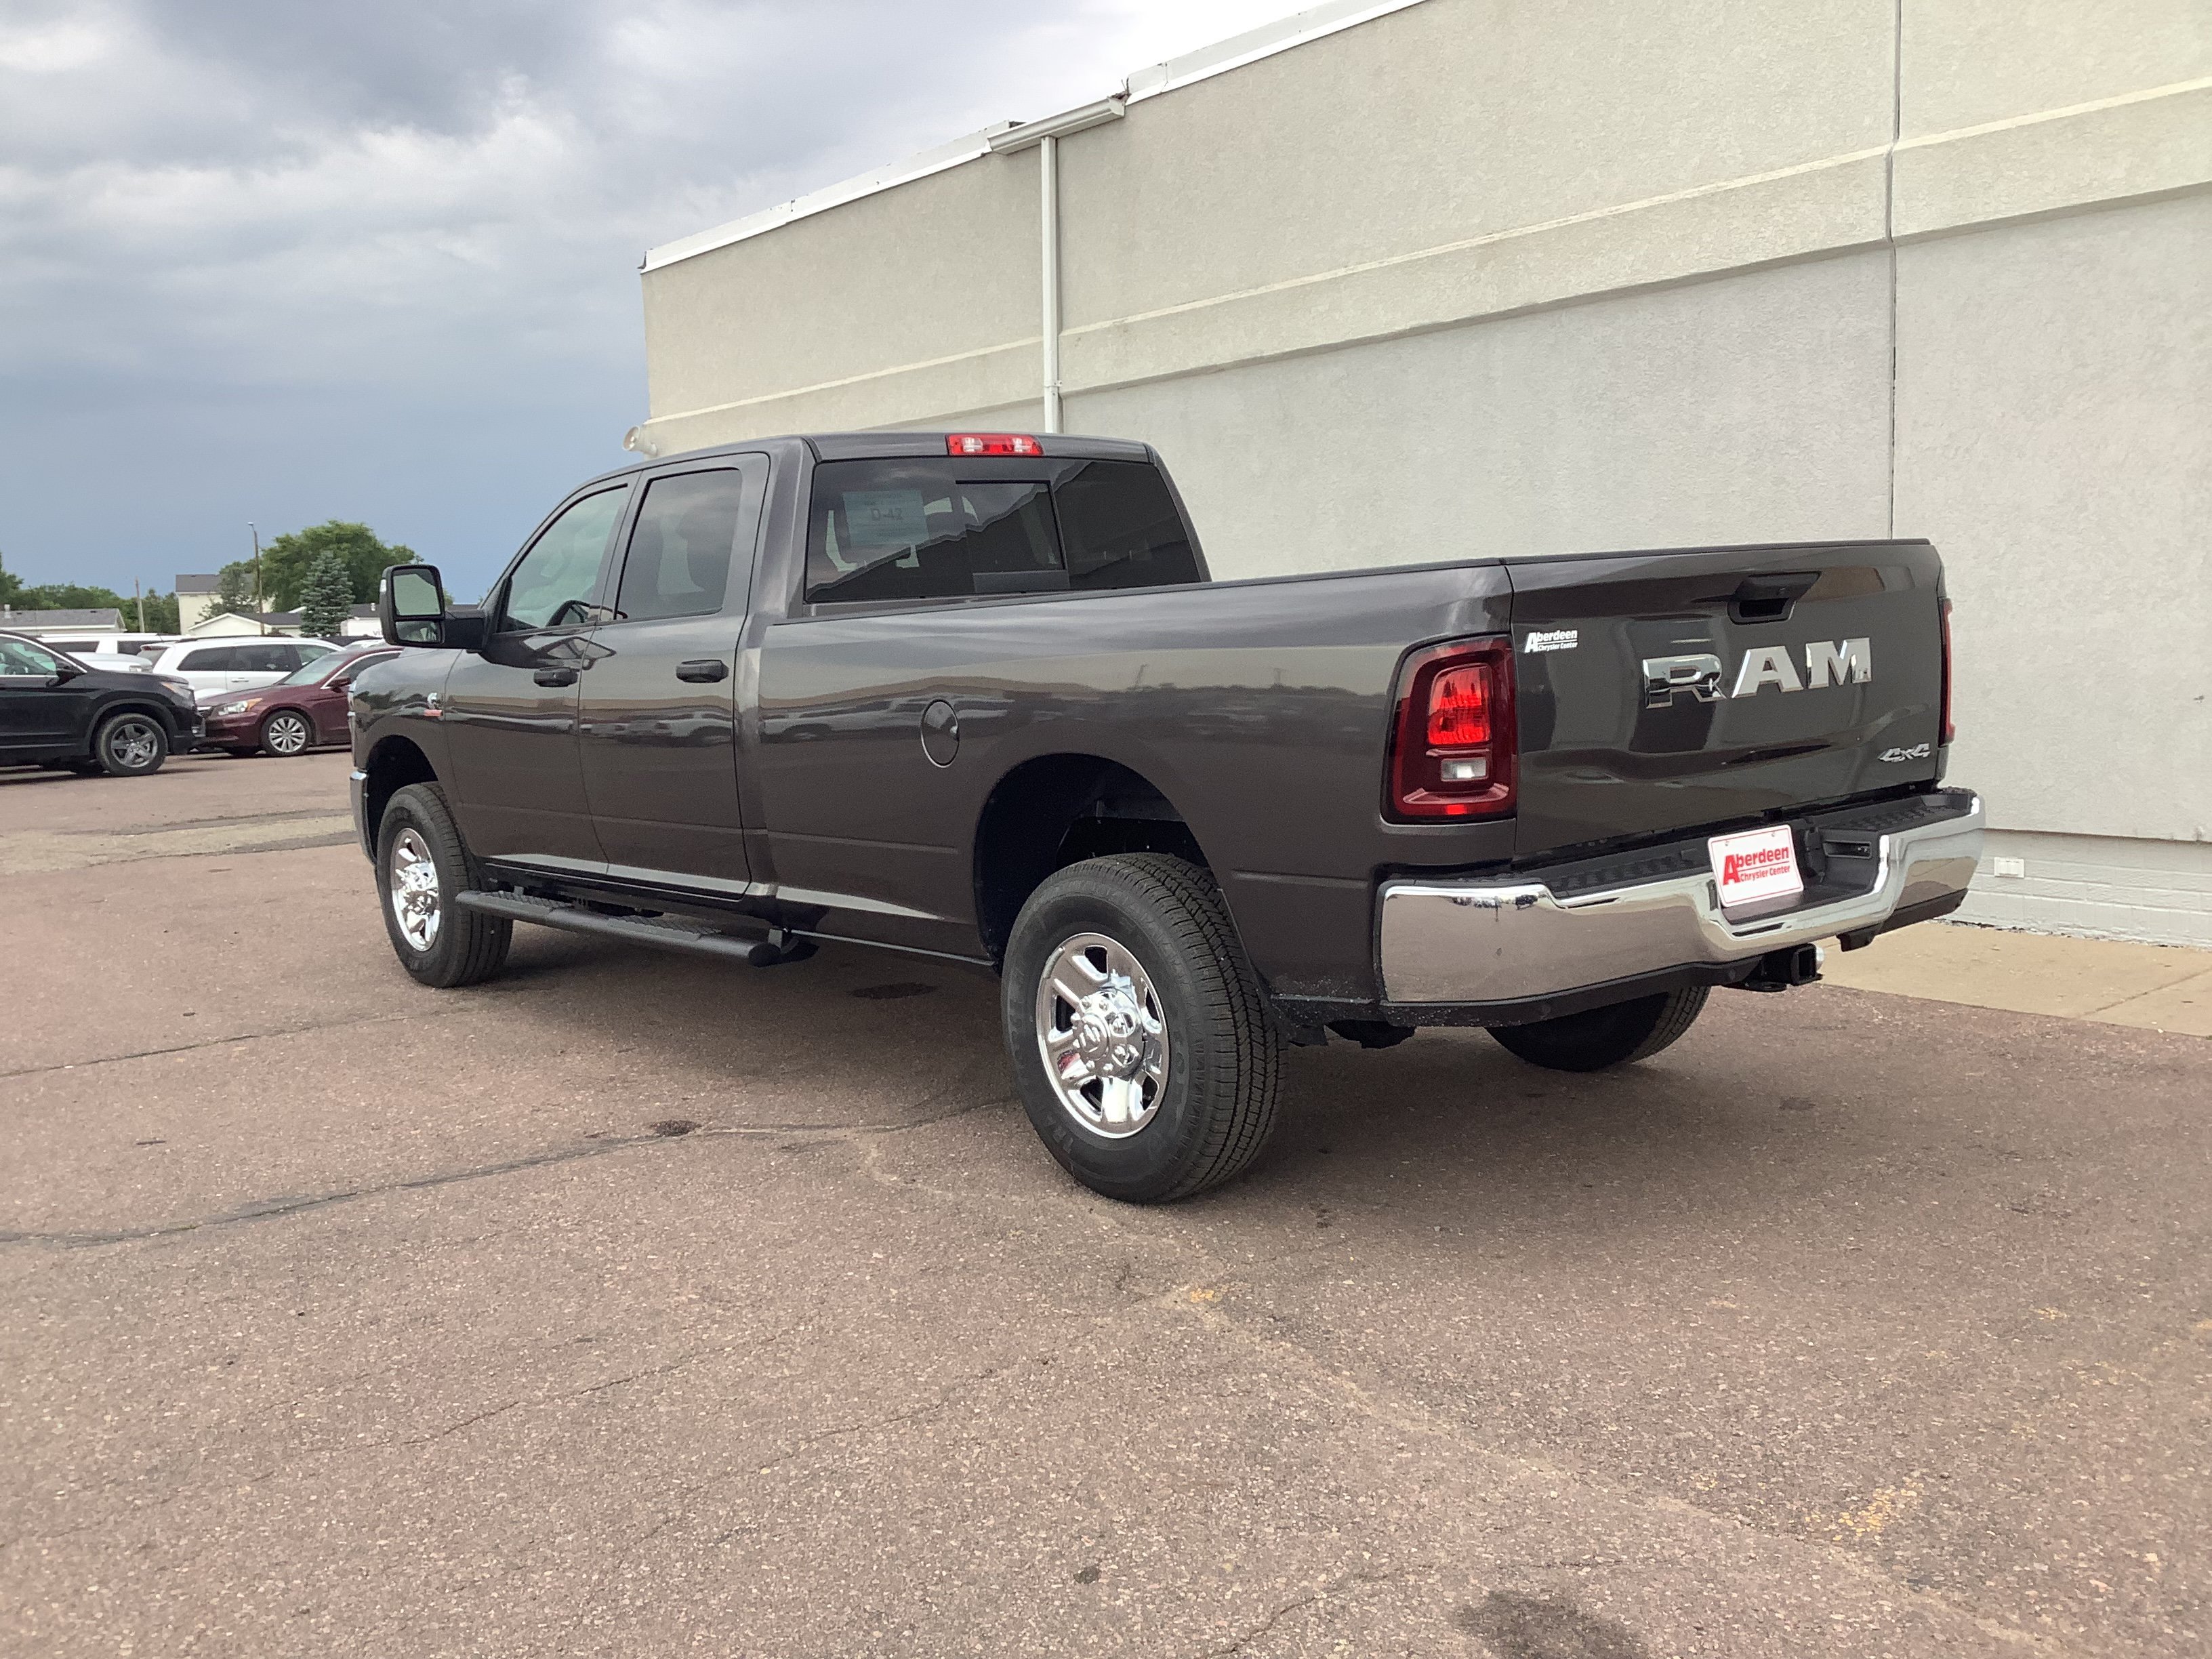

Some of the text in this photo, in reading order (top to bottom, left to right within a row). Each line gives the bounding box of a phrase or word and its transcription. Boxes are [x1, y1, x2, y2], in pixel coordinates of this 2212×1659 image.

[1524, 630, 1578, 653] Aberdeen
[1538, 643, 1560, 652] Chrysler
[1643, 637, 1872, 709] RAM
[1723, 846, 1789, 886] Aberdeen
[1740, 865, 1790, 881] Chrysler Center
